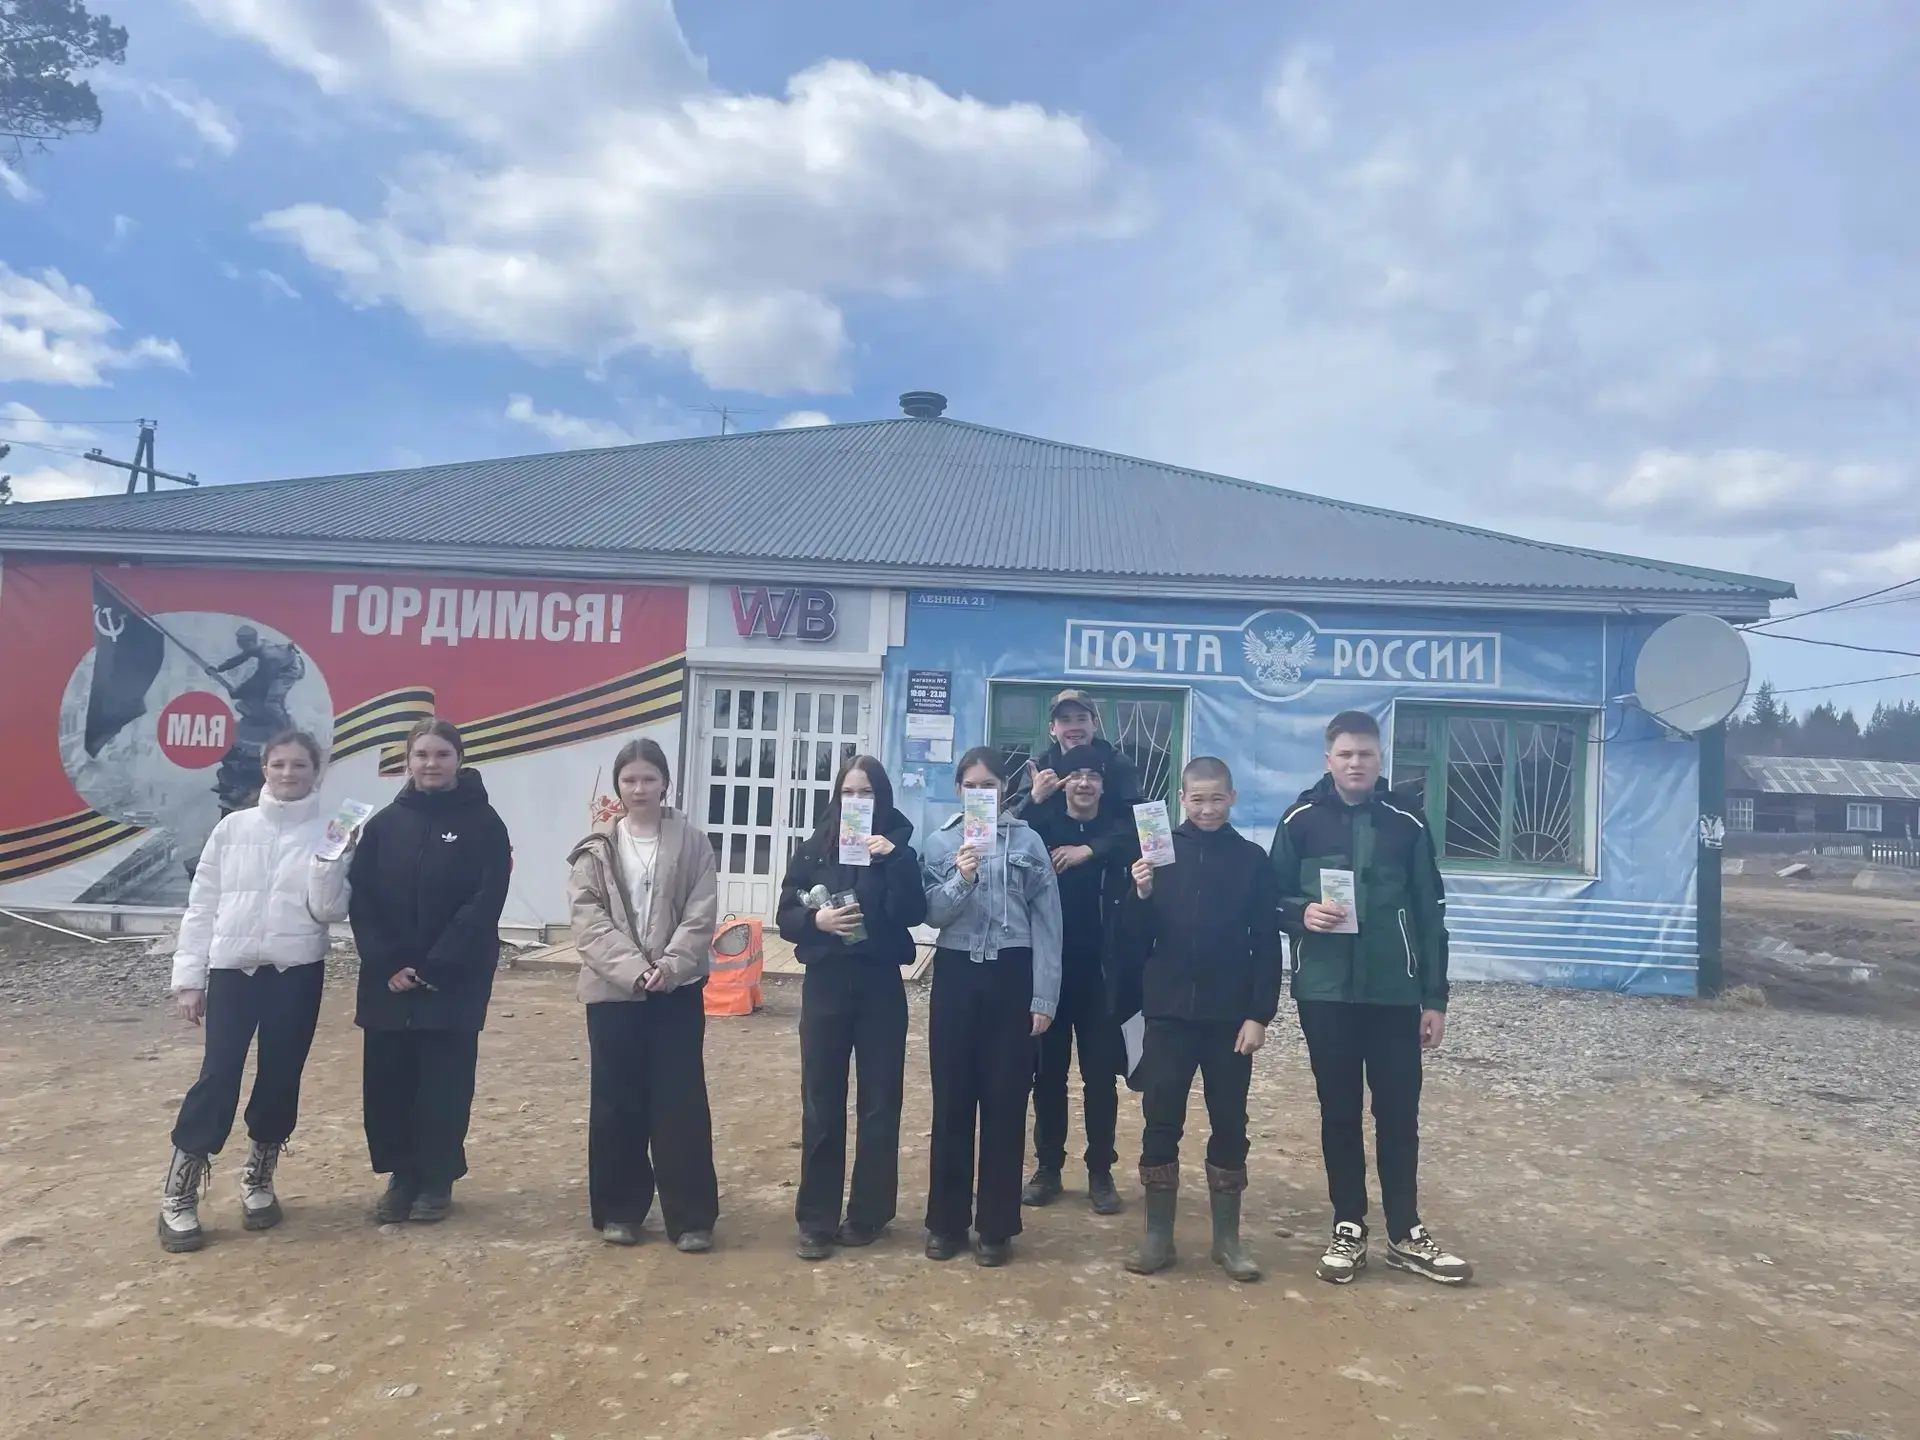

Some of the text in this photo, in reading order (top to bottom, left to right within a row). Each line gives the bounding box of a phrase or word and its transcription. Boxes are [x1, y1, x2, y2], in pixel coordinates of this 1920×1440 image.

[331, 584, 624, 646] ГОРДИМСЯ!
[729, 586, 837, 641] WB
[918, 594, 985, 606] ЛЕНИНА 21
[1080, 629, 1484, 680] ПОЧТА РОССИИ
[166, 713, 227, 748] МАЯ
